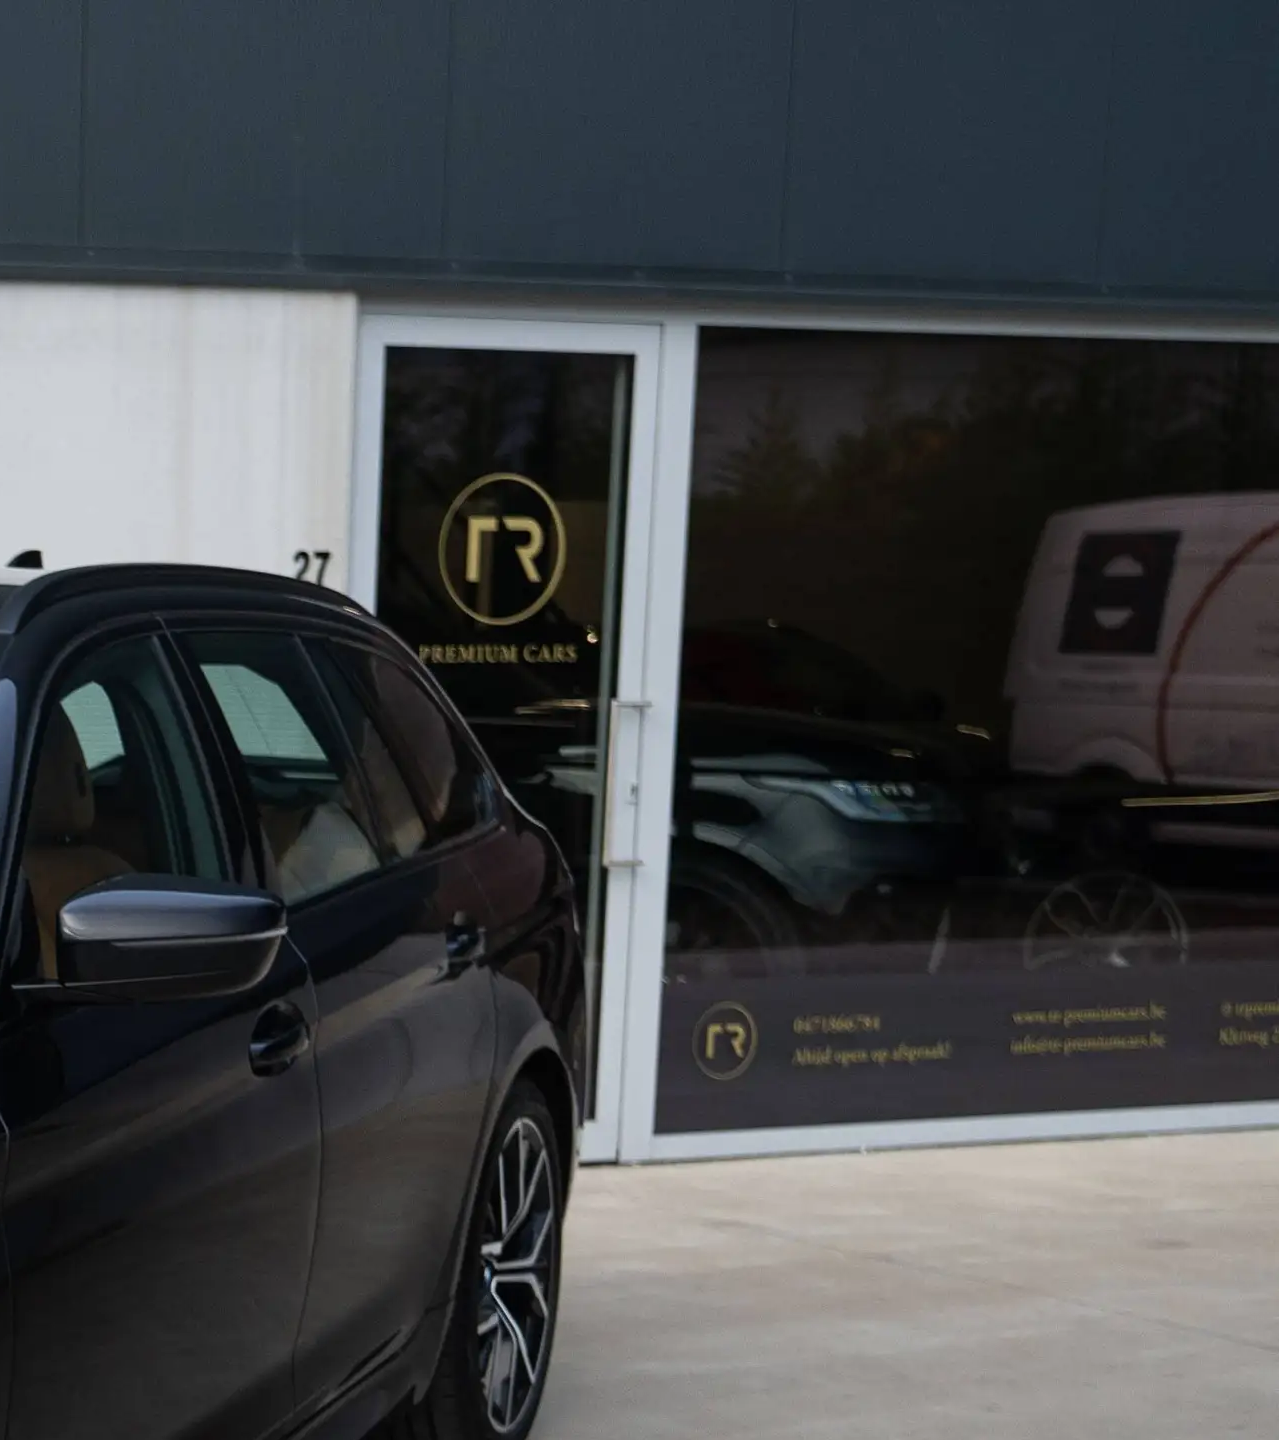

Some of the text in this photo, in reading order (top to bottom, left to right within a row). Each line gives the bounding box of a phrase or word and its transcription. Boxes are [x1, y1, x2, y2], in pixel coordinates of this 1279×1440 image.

[293, 551, 331, 586] 27
[418, 643, 579, 664] PREMIUM CARS
